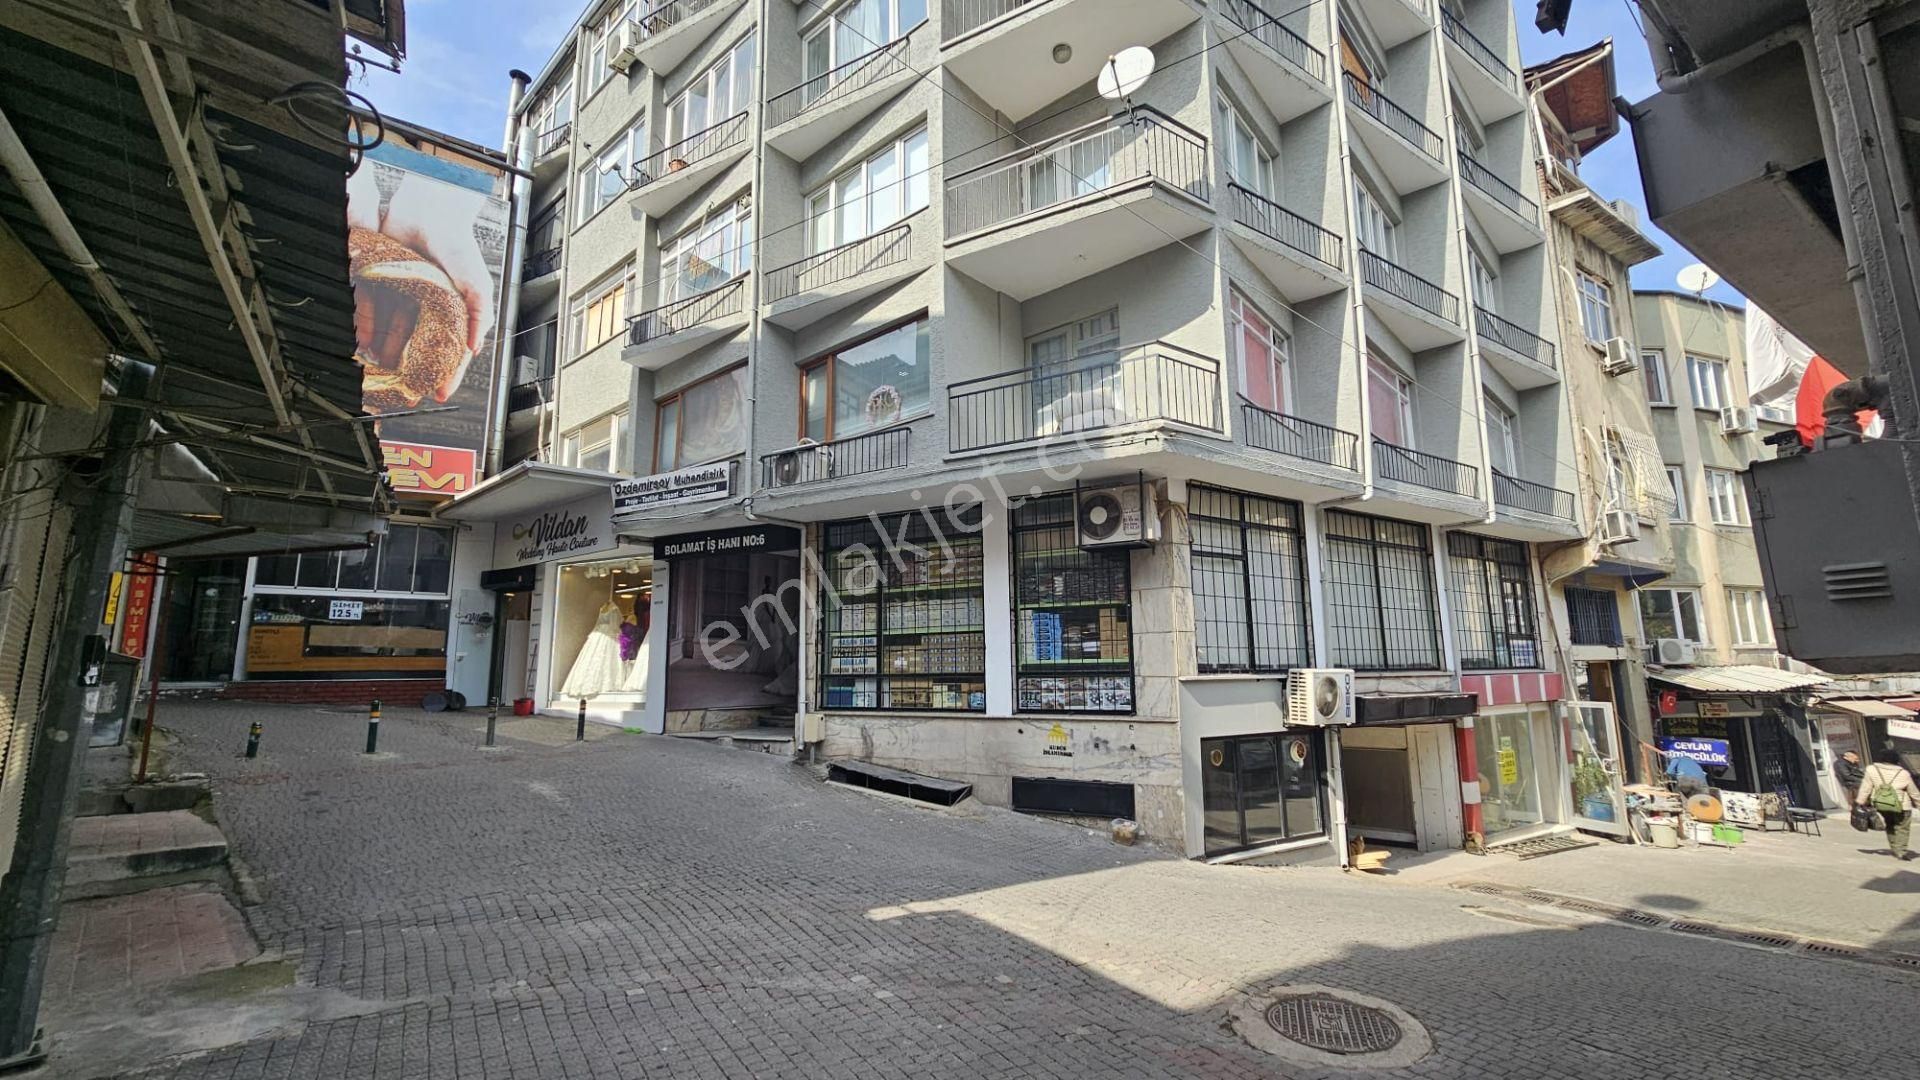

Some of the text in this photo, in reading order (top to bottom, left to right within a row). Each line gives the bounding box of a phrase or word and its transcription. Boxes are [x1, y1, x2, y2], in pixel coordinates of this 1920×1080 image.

[528, 510, 589, 548] Vildan
[569, 536, 598, 551] Couture
[664, 541, 705, 555] BOLAMAT
[718, 537, 740, 549] HANI
[743, 534, 765, 547] NO:6
[1674, 742, 1712, 752] CEYLAN
